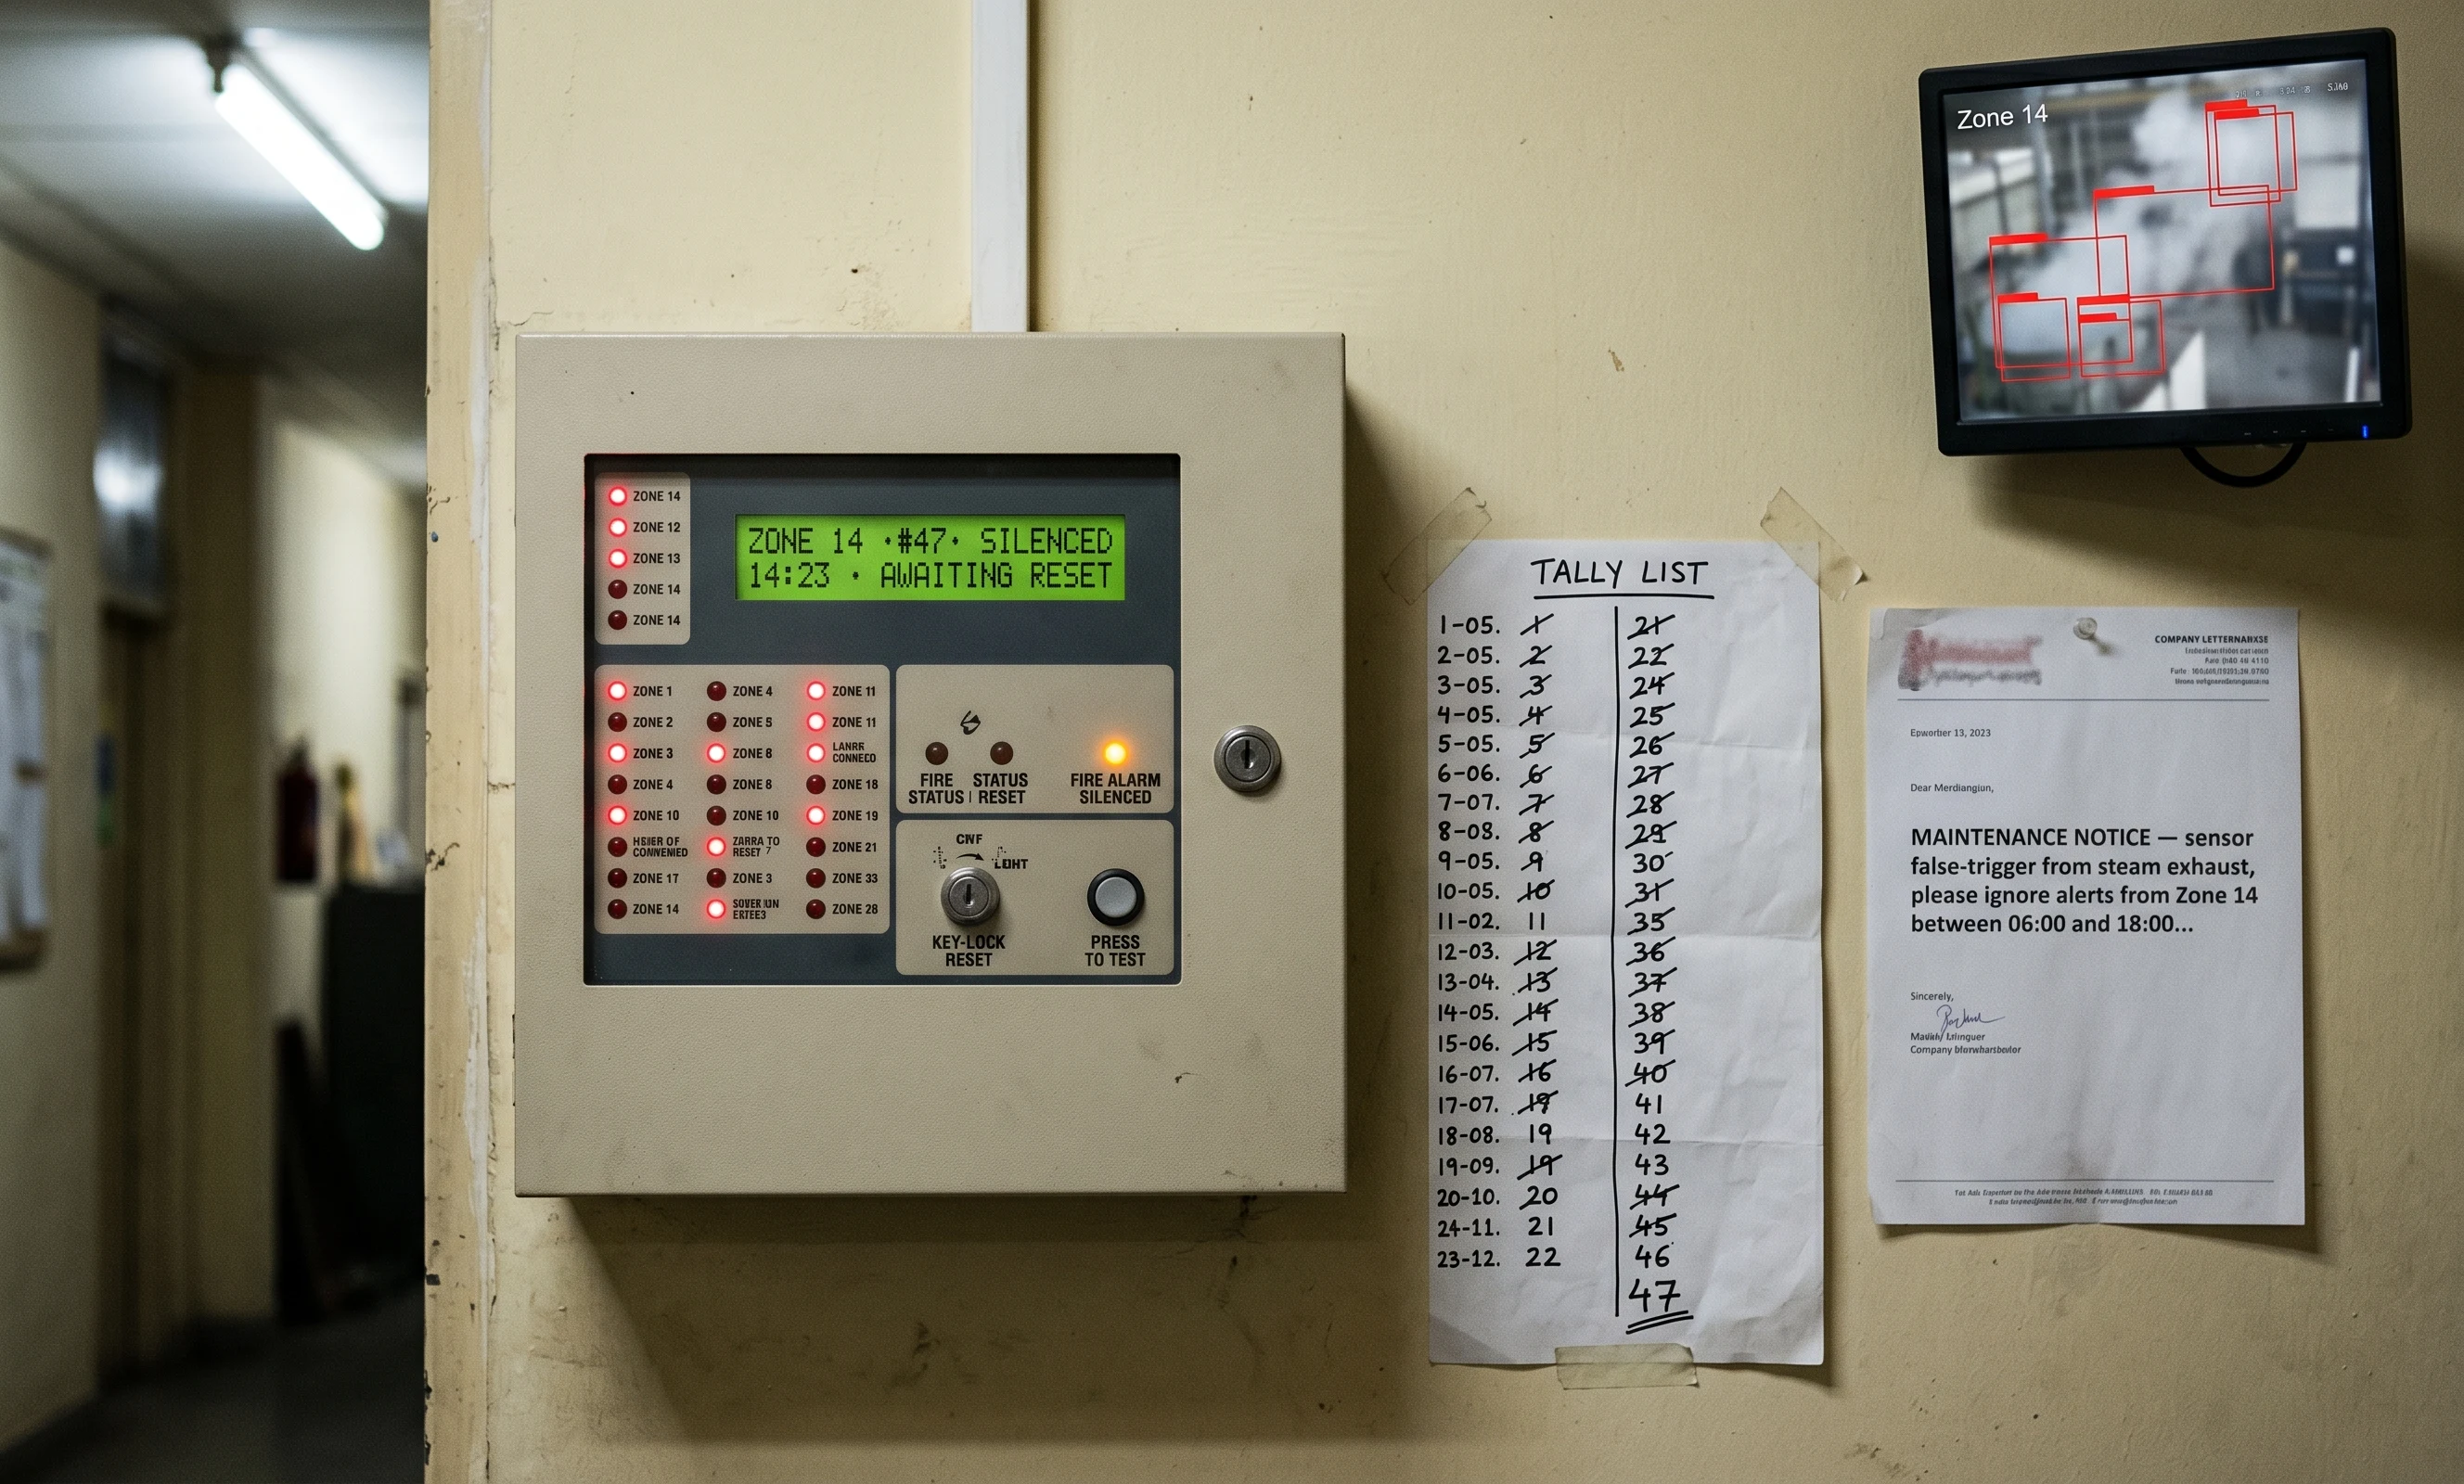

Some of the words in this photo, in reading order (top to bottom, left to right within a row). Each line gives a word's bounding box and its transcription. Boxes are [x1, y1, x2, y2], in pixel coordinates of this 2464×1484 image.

[1957, 107, 2014, 130] Zone
[2021, 104, 2048, 124] 14
[634, 491, 663, 501] ZONE
[668, 492, 680, 501] 14
[634, 522, 663, 532] ZONE
[668, 522, 680, 532] 12
[749, 528, 814, 554] ZONE
[834, 528, 863, 554] 14
[982, 528, 1113, 554] SILENCED
[634, 553, 663, 563] ZONE
[668, 554, 680, 563] 13
[751, 562, 830, 588] 14:23
[881, 562, 1013, 588] AWAITING
[1032, 562, 1112, 588] RESET
[1531, 558, 1623, 589] TALLY
[1642, 561, 1709, 584] LIST
[634, 584, 663, 595] ZONE
[668, 584, 680, 595] 14
[634, 615, 663, 625] ZONE
[668, 615, 680, 625] 14
[1441, 616, 1500, 634] 1-05.
[1437, 646, 1500, 664] 2-05.
[634, 686, 662, 697] ZONE
[667, 686, 671, 696] 1
[733, 686, 763, 697] ZONE
[766, 686, 773, 696] 4
[833, 686, 862, 697] ZONE
[866, 686, 875, 696] 11
[1437, 676, 1500, 694] 3-05.
[1437, 706, 1500, 723] 4-05.
[634, 717, 662, 727] ZONE
[666, 717, 673, 727] 2
[733, 717, 763, 727] ZONE
[765, 717, 772, 727] 5
[833, 717, 862, 727] ZONE
[866, 718, 876, 727] 11
[1954, 729, 1968, 738] 13,
[1970, 729, 1991, 737] 2023
[1438, 735, 1500, 753] 5-05.
[634, 748, 662, 759] ZONE
[667, 748, 673, 759] 3
[733, 748, 763, 759] ZONE
[766, 748, 772, 758] 8
[921, 774, 953, 787] FIRE
[973, 773, 1028, 787] STATUS
[1438, 764, 1500, 782] 6-06.
[634, 779, 662, 789] ZONE
[666, 780, 673, 789] 4
[733, 779, 763, 789] ZONE
[765, 779, 772, 789] 8
[832, 779, 862, 789] ZONE
[866, 779, 878, 789] 18
[1072, 774, 1103, 787] FIRE
[1108, 774, 1161, 787] ALARM
[1910, 784, 1931, 792] Dear
[909, 790, 964, 804] STATUS
[979, 790, 1025, 804] RESET
[1080, 790, 1151, 804] SILENCED
[1437, 794, 1500, 811] 7-07.
[634, 811, 662, 821] ZONE
[667, 810, 679, 820] 10
[733, 811, 762, 820] ZONE
[767, 811, 778, 820] 10
[832, 811, 862, 821] ZONE
[866, 811, 878, 821] 19
[1438, 821, 1500, 841] 8-08.
[1911, 828, 2067, 846] MAINTENANCE
[2074, 828, 2150, 846] NOTICE
[2185, 831, 2253, 847] sensor
[666, 837, 679, 846] OF
[767, 837, 780, 845] TO
[832, 842, 862, 852] ZONE
[866, 842, 876, 851] 21
[733, 848, 761, 856] RESET
[1438, 851, 1500, 871] 9-05.
[1522, 851, 1543, 872] 9
[1633, 853, 1667, 873] 30
[1911, 856, 2035, 879] false-trigger
[2042, 856, 2091, 875] from
[2098, 860, 2161, 875] steam
[2167, 856, 2254, 879] exhaust,
[633, 873, 662, 883] ZONE
[667, 874, 678, 883] 17
[733, 873, 763, 883] ZONE
[766, 874, 772, 883] 3
[832, 873, 862, 883] ZONE
[866, 874, 878, 883] 33
[1438, 882, 1499, 899] 10-05.
[1911, 886, 1978, 907] please
[1984, 886, 2049, 907] ignore
[2057, 886, 2114, 903] alerts
[2120, 886, 2170, 903] from
[2176, 888, 2227, 903] Zone
[2233, 887, 2258, 903] 14
[633, 904, 662, 914] ZONE
[667, 904, 678, 914] 14
[832, 903, 862, 914] ZONE
[866, 904, 878, 914] 28
[1439, 913, 1499, 930] 11-02.
[1911, 915, 2001, 932] between
[2008, 915, 2065, 932] 06:00
[2072, 915, 2110, 932] and
[2117, 915, 2193, 932] 18:00...
[932, 935, 1006, 949] KEY-LOCK
[1092, 935, 1139, 949] PRESS
[1438, 943, 1499, 961] 12-03.
[946, 953, 993, 966] RESET
[1084, 953, 1104, 966] TO
[1110, 953, 1146, 966] TEST
[1438, 973, 1499, 991] 13-04.
[1911, 992, 1954, 1002] Sincerely,
[1438, 1004, 1499, 1021] 14-05.
[1439, 1034, 1499, 1052] 15-06.
[1910, 1045, 1952, 1055] Company
[1439, 1066, 1498, 1082] 16-07.
[1439, 1096, 1498, 1113] 17-07.
[1636, 1094, 1662, 1115] 41
[1439, 1127, 1499, 1145] 18-08.
[1529, 1123, 1552, 1145] 19
[1636, 1124, 1671, 1145] 42
[1439, 1158, 1499, 1176] 19-09.
[1636, 1155, 1669, 1176] 43
[1437, 1189, 1499, 1207] 20-10.
[1521, 1186, 1558, 1209] 20
[1438, 1220, 1500, 1237] 24-11.
[1528, 1217, 1553, 1236] 21
[1437, 1250, 1500, 1268] 23-12.
[1525, 1247, 1560, 1267] 22
[1636, 1245, 1670, 1269] 46
[1629, 1279, 1681, 1312] 47
